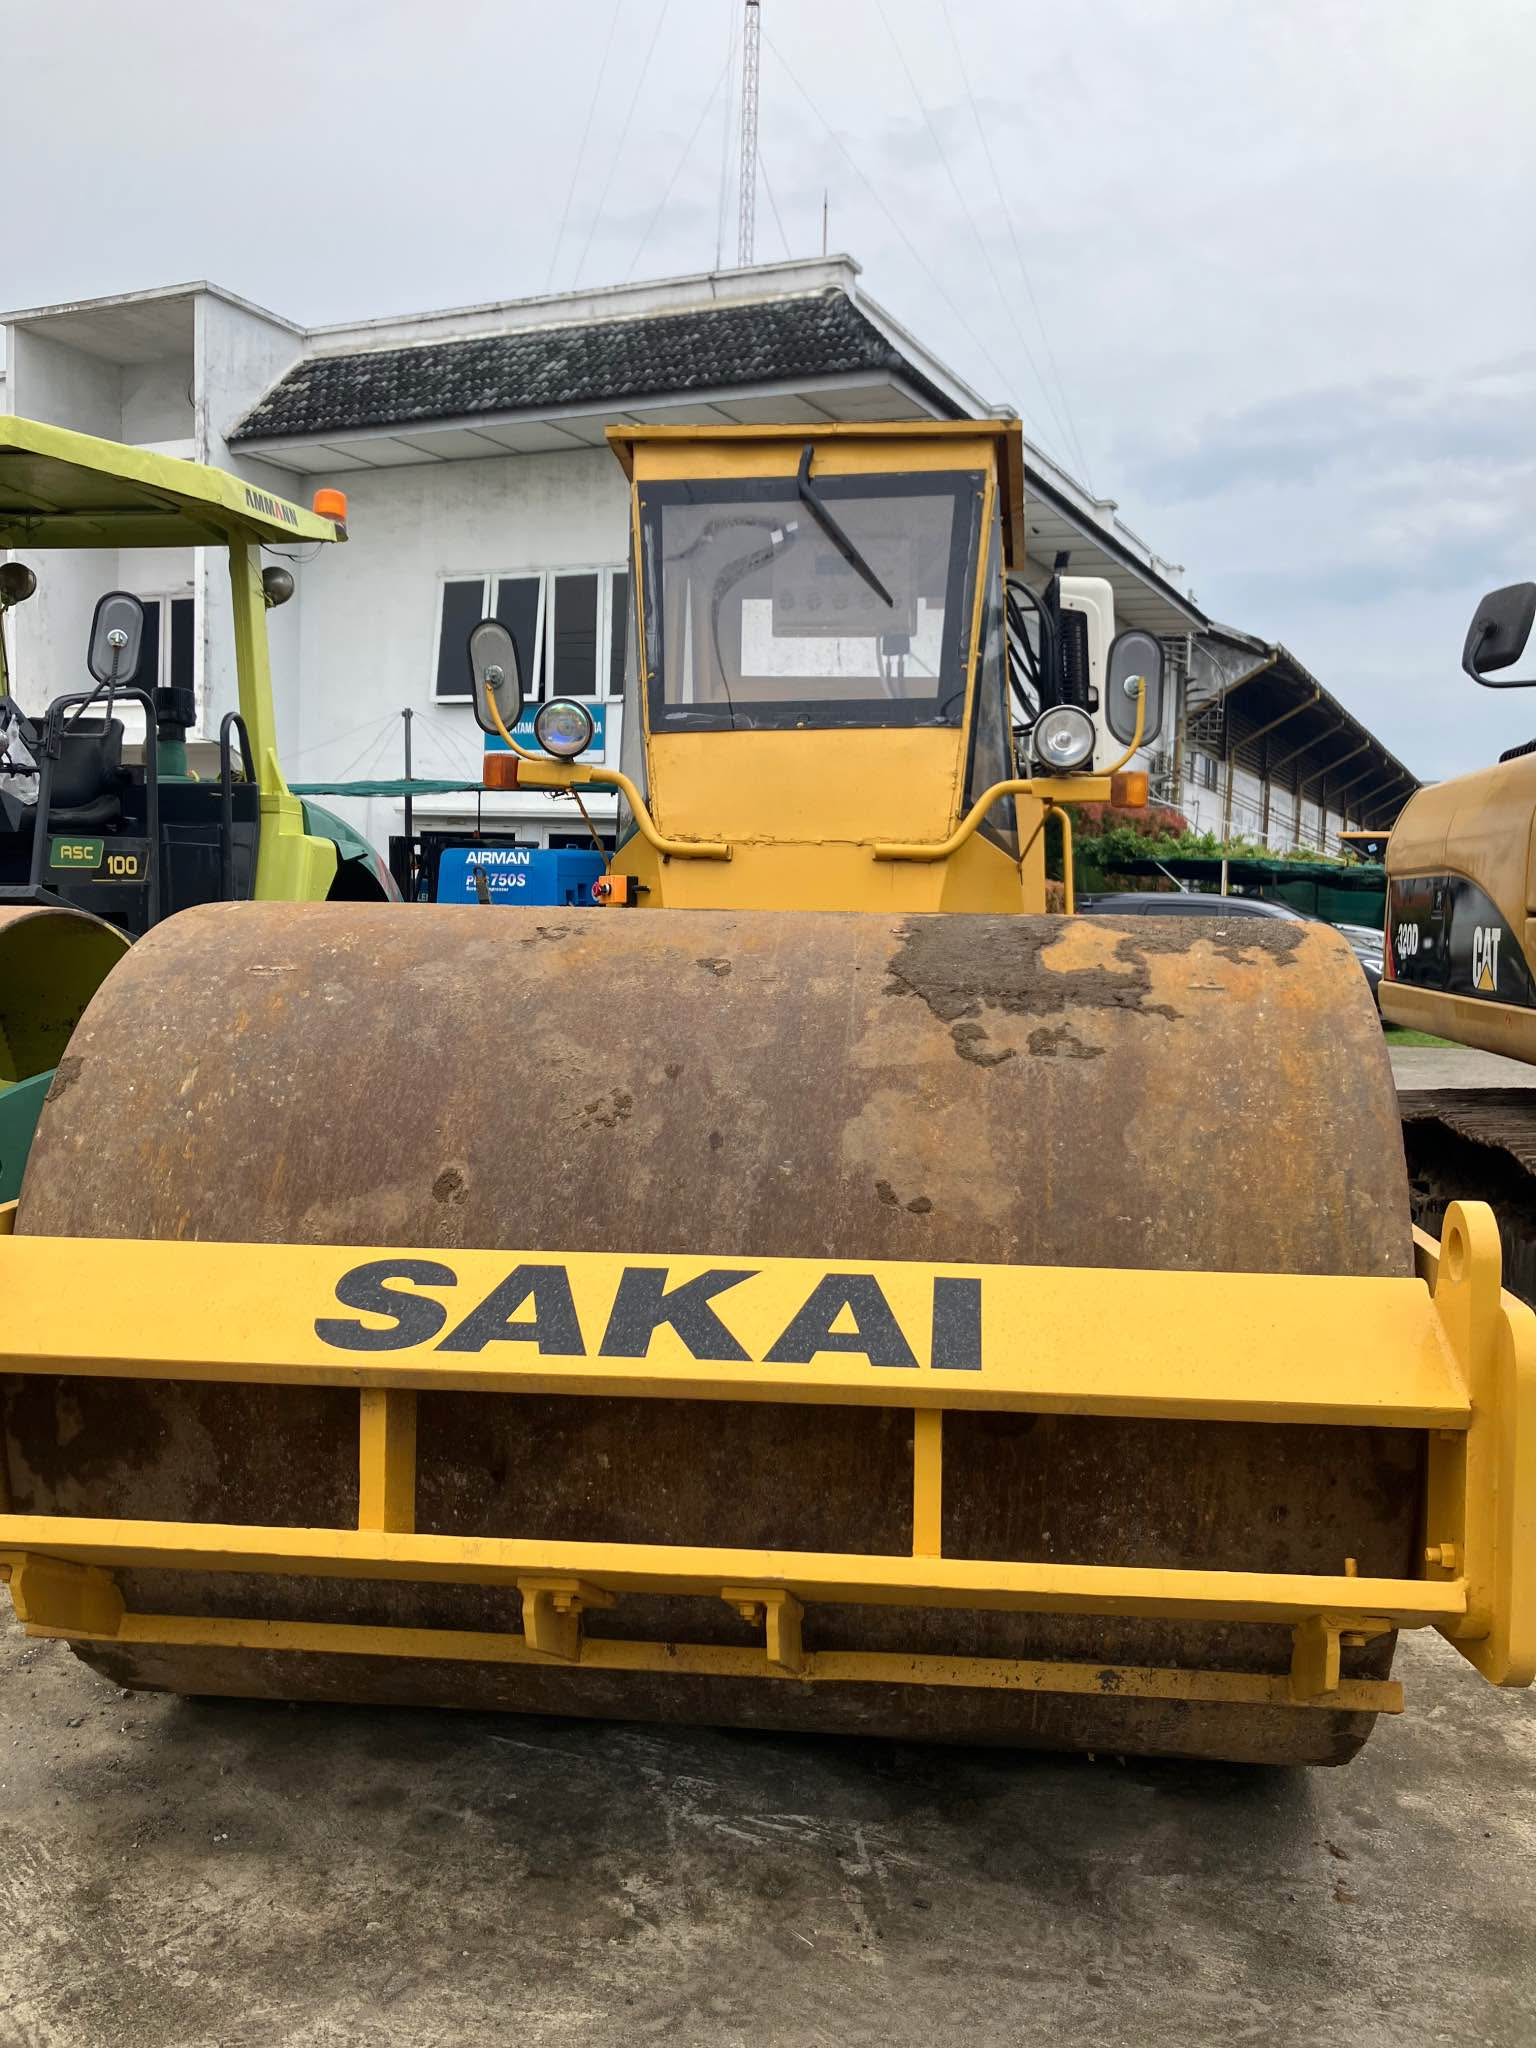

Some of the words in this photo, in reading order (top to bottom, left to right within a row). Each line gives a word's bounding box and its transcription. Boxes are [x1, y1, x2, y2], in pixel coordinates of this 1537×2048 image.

[245, 488, 299, 528] AMMANN
[61, 845, 93, 860] ASC
[107, 856, 138, 875] 100
[465, 851, 530, 865] AIRMAN
[1397, 922, 1419, 956] 320D
[1472, 926, 1502, 991] CAT
[314, 1258, 982, 1371] SAKAI
